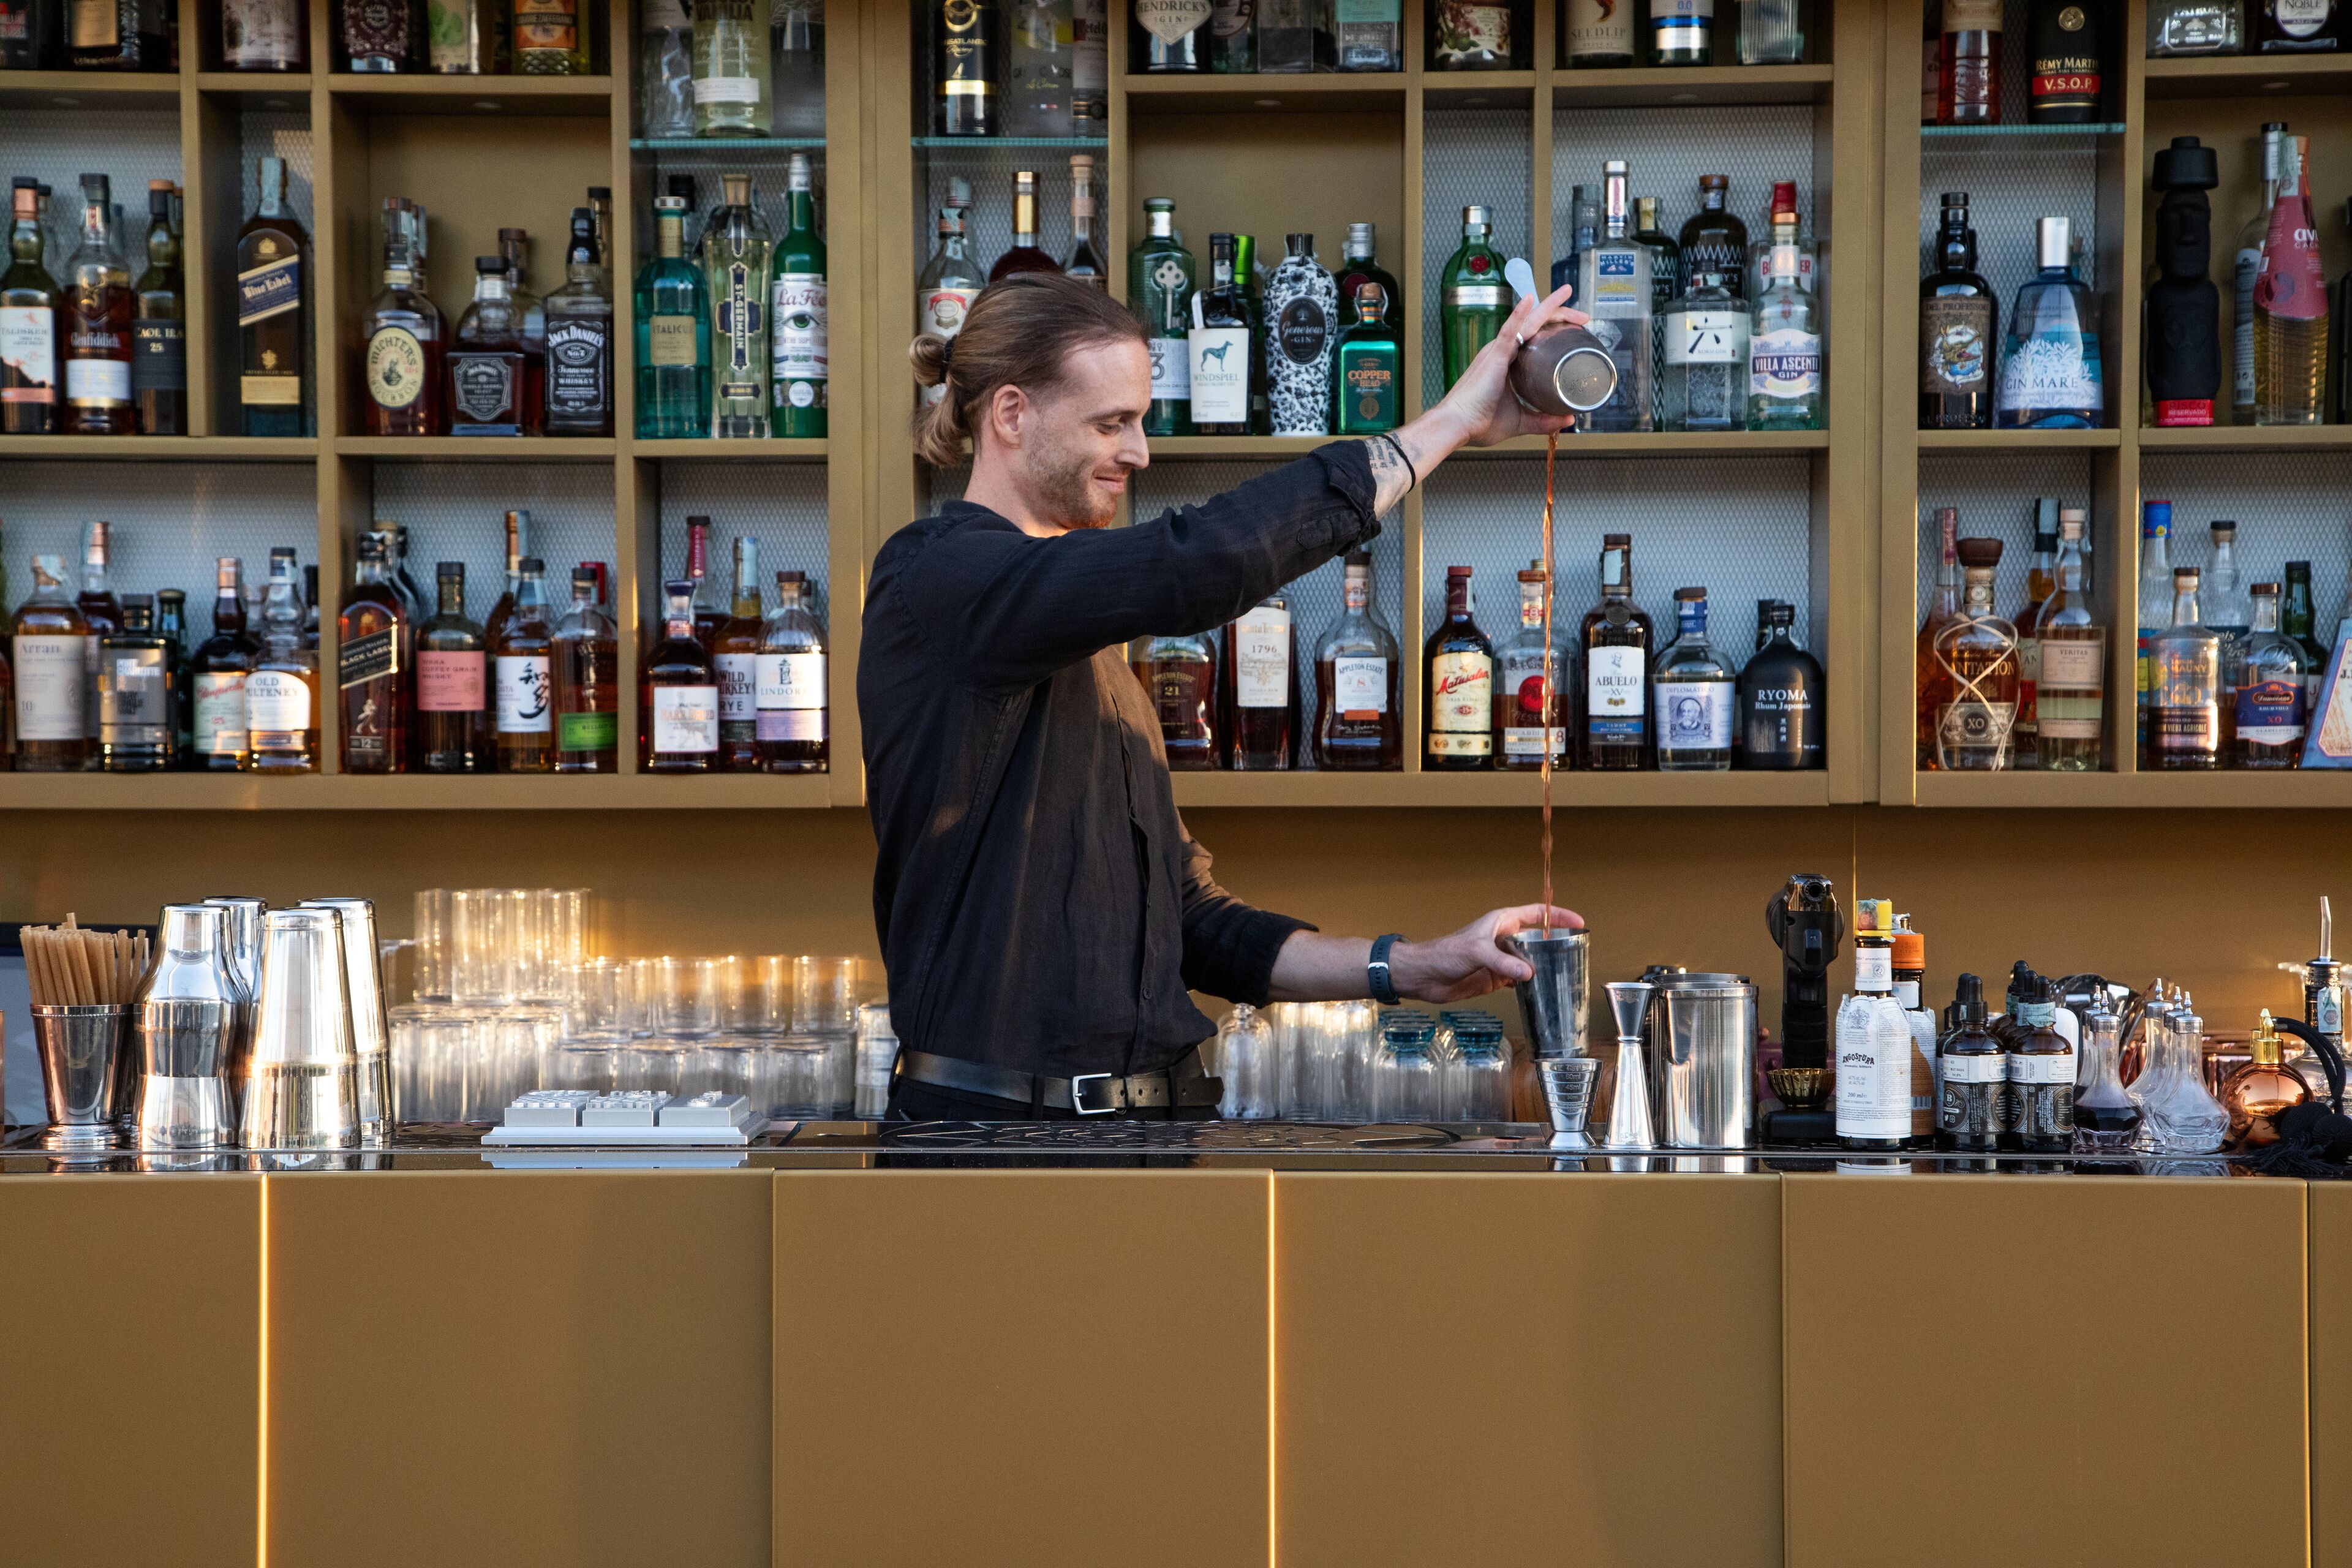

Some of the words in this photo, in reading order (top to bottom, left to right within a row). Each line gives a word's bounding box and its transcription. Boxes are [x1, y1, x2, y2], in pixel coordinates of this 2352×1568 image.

[778, 288, 797, 306] La
[734, 283, 745, 350] ST-GERMAIN
[1282, 320, 1324, 339] Generous
[548, 328, 570, 347] JACK
[569, 325, 605, 349] DANIEL'S
[149, 342, 165, 353] 25
[1755, 356, 1779, 371] VILLA
[1348, 369, 1392, 380] COPPER
[2005, 377, 2027, 390] GIN
[2032, 377, 2078, 388] MARE
[1251, 644, 1278, 654] 1796
[1338, 663, 1365, 675] APPLETON
[2340, 669, 2352, 679] J.
[255, 676, 279, 685] OLD
[719, 670, 745, 682] WILD
[1595, 676, 1637, 686] ABUELO
[719, 682, 750, 695] URKEY
[1164, 685, 1180, 696] 21
[1758, 689, 1808, 701] RYOMA
[720, 700, 744, 712] RYE
[1755, 701, 1777, 710] Rhum
[1778, 701, 1811, 712] Japonais
[1967, 718, 1985, 729] XO
[2183, 722, 2207, 732] AGRICOLE
[360, 737, 372, 748] 12
[1555, 729, 1565, 744] 8
[1842, 1052, 1875, 1065] ANGOSTURA
